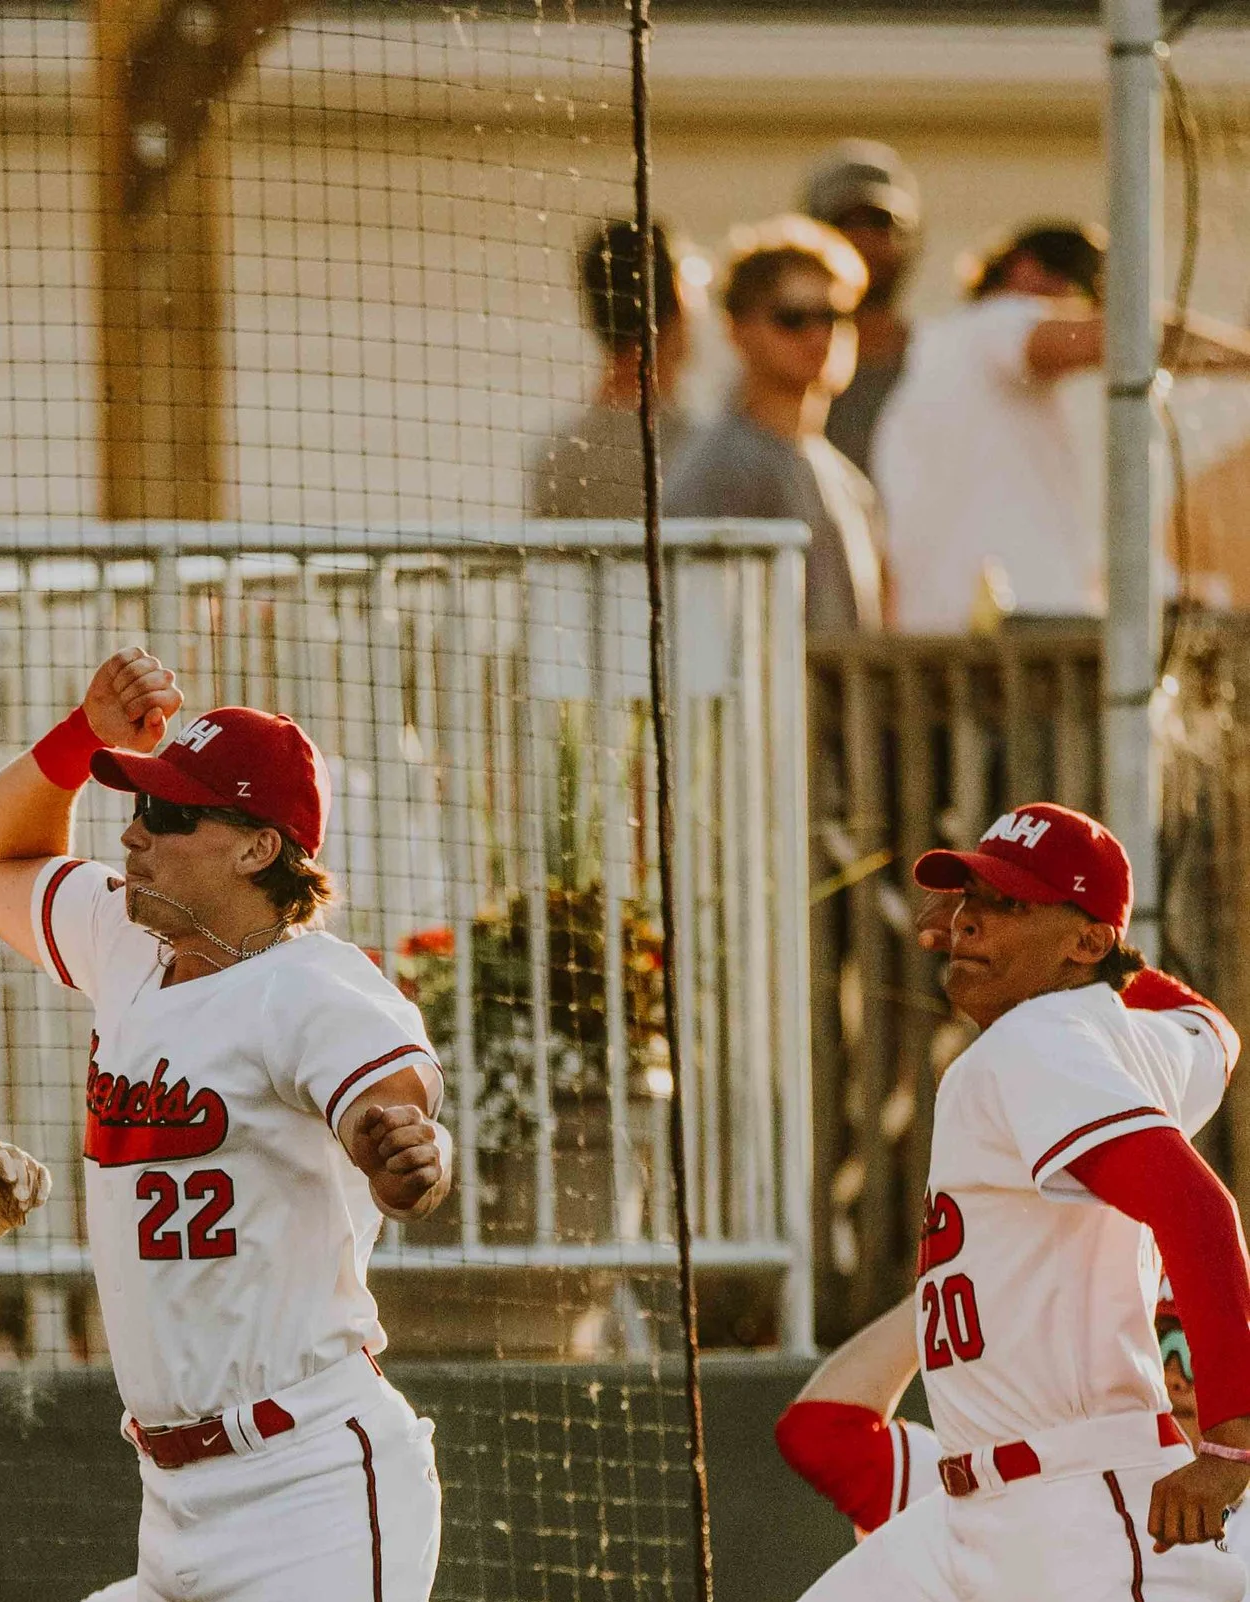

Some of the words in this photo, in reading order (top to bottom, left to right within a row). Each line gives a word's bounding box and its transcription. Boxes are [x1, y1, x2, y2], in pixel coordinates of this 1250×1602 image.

[237, 782, 251, 797] Z
[1073, 876, 1086, 892] Z
[136, 1168, 237, 1261] 22
[922, 1272, 985, 1371] 20
